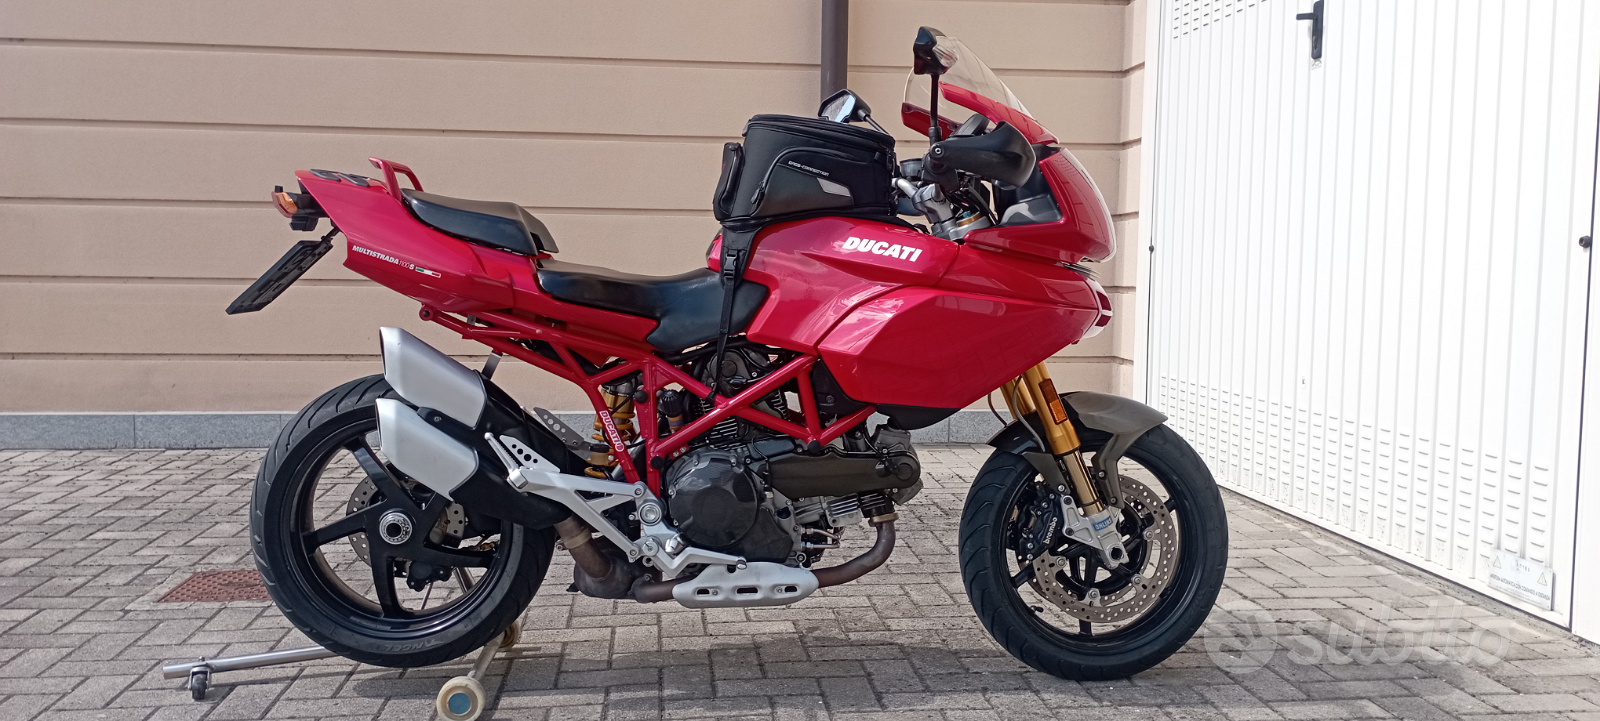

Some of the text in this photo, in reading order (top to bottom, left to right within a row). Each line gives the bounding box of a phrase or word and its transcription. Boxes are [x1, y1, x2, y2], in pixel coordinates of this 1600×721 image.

[352, 245, 399, 265] MULTISTRADA
[841, 236, 923, 262] DUCATI
[599, 410, 622, 444] DUCATI
[1043, 517, 1058, 545] brembo
